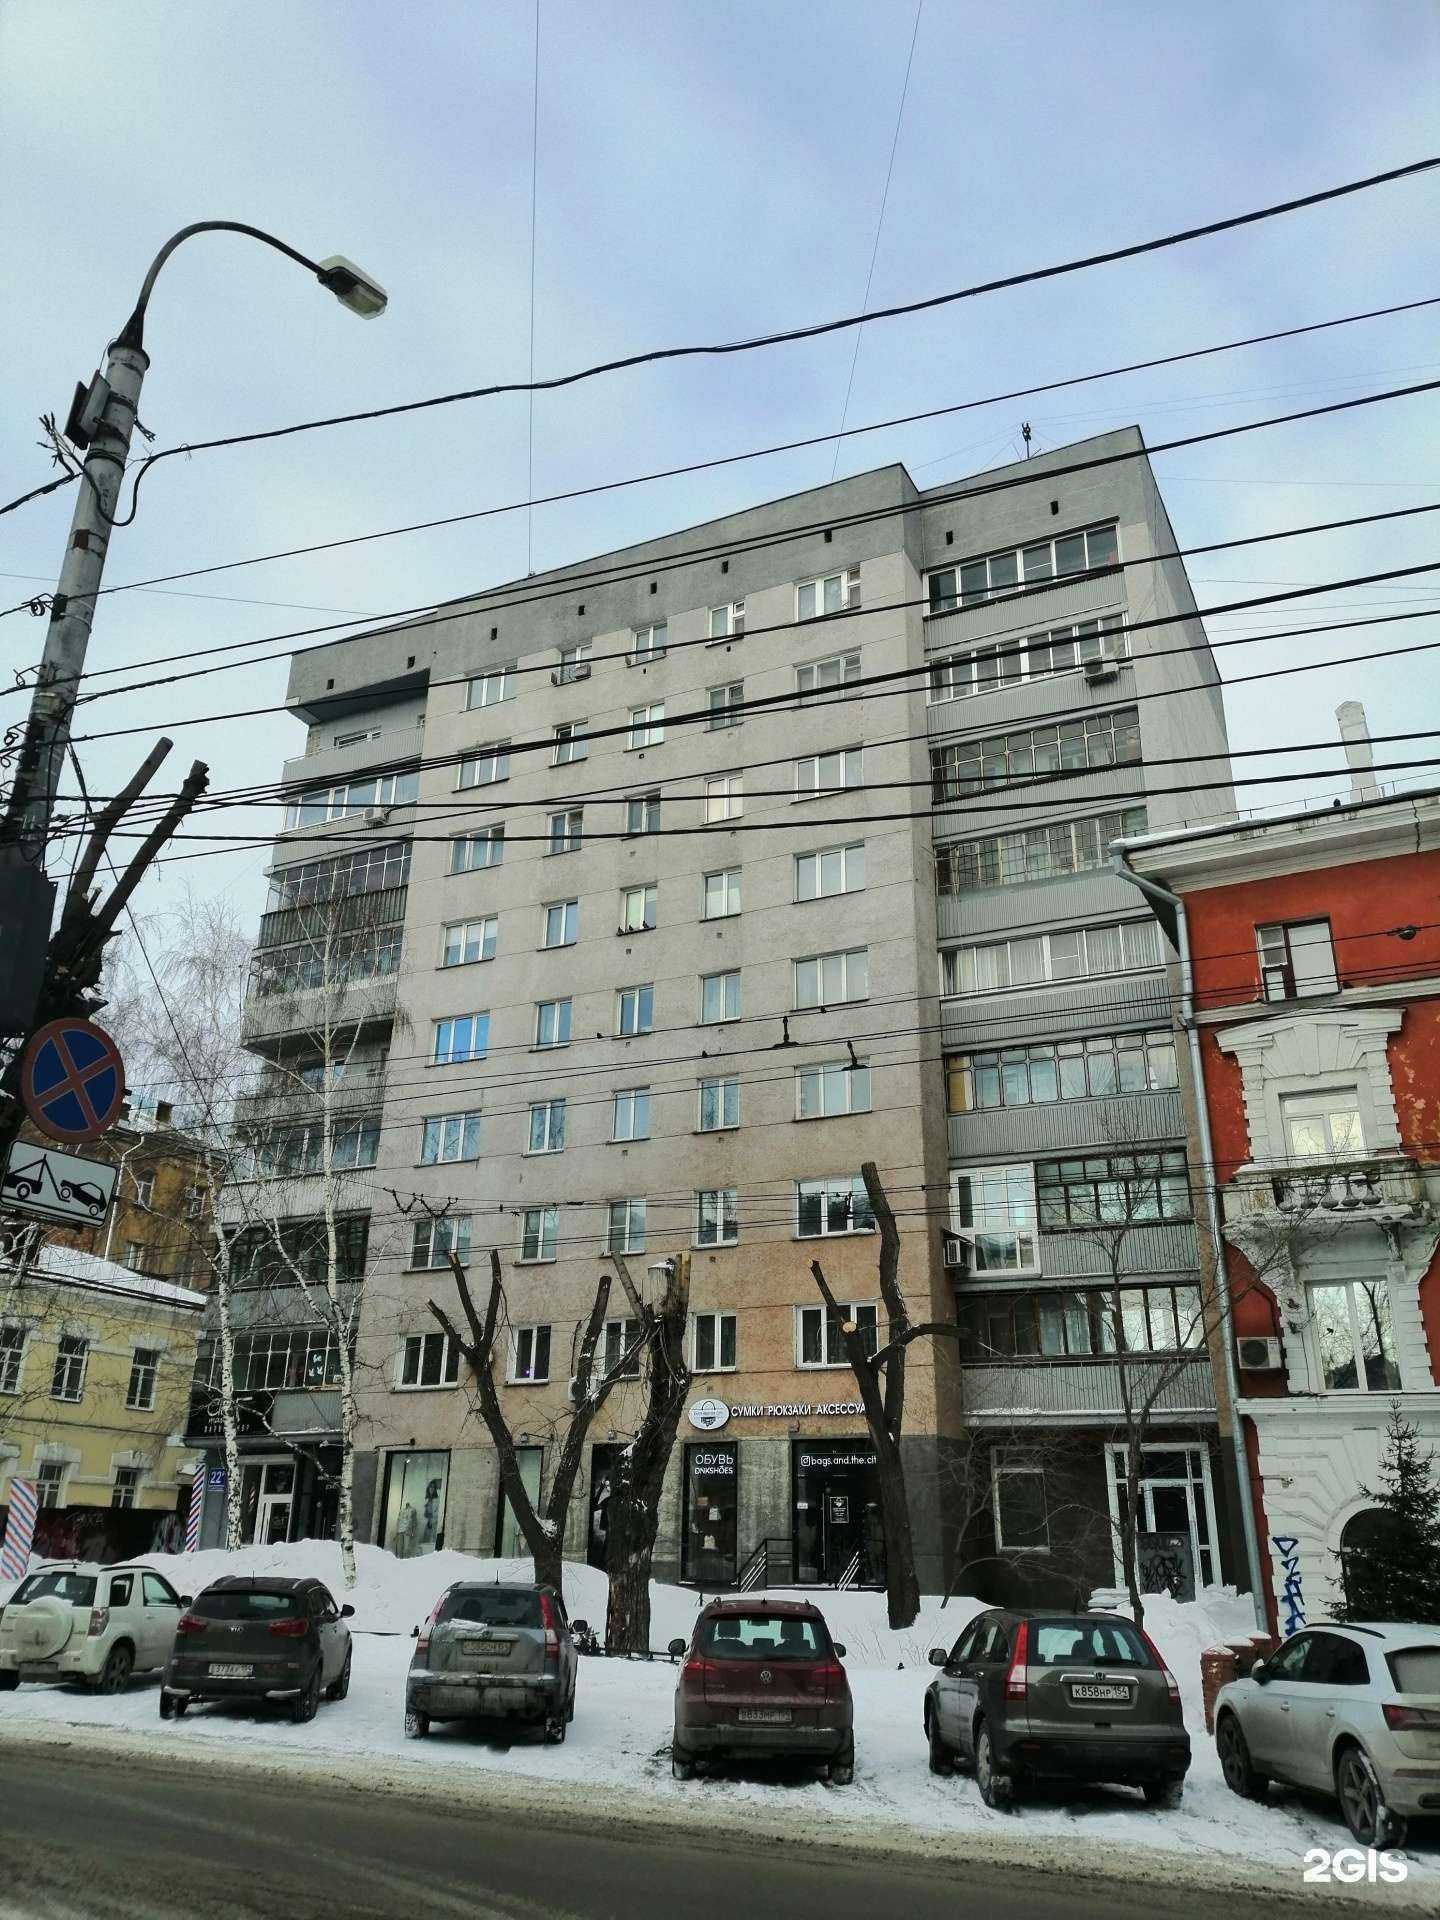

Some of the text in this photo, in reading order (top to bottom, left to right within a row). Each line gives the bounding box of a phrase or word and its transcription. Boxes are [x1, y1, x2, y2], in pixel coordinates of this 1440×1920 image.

[731, 1406, 764, 1417] СУМКИ
[768, 1404, 811, 1416] РЮКЗАКИ
[816, 1403, 866, 1415] АКСЕССУА
[695, 1454, 734, 1465] ОБУВЬ
[810, 1454, 877, 1467] bags.and.the.cit
